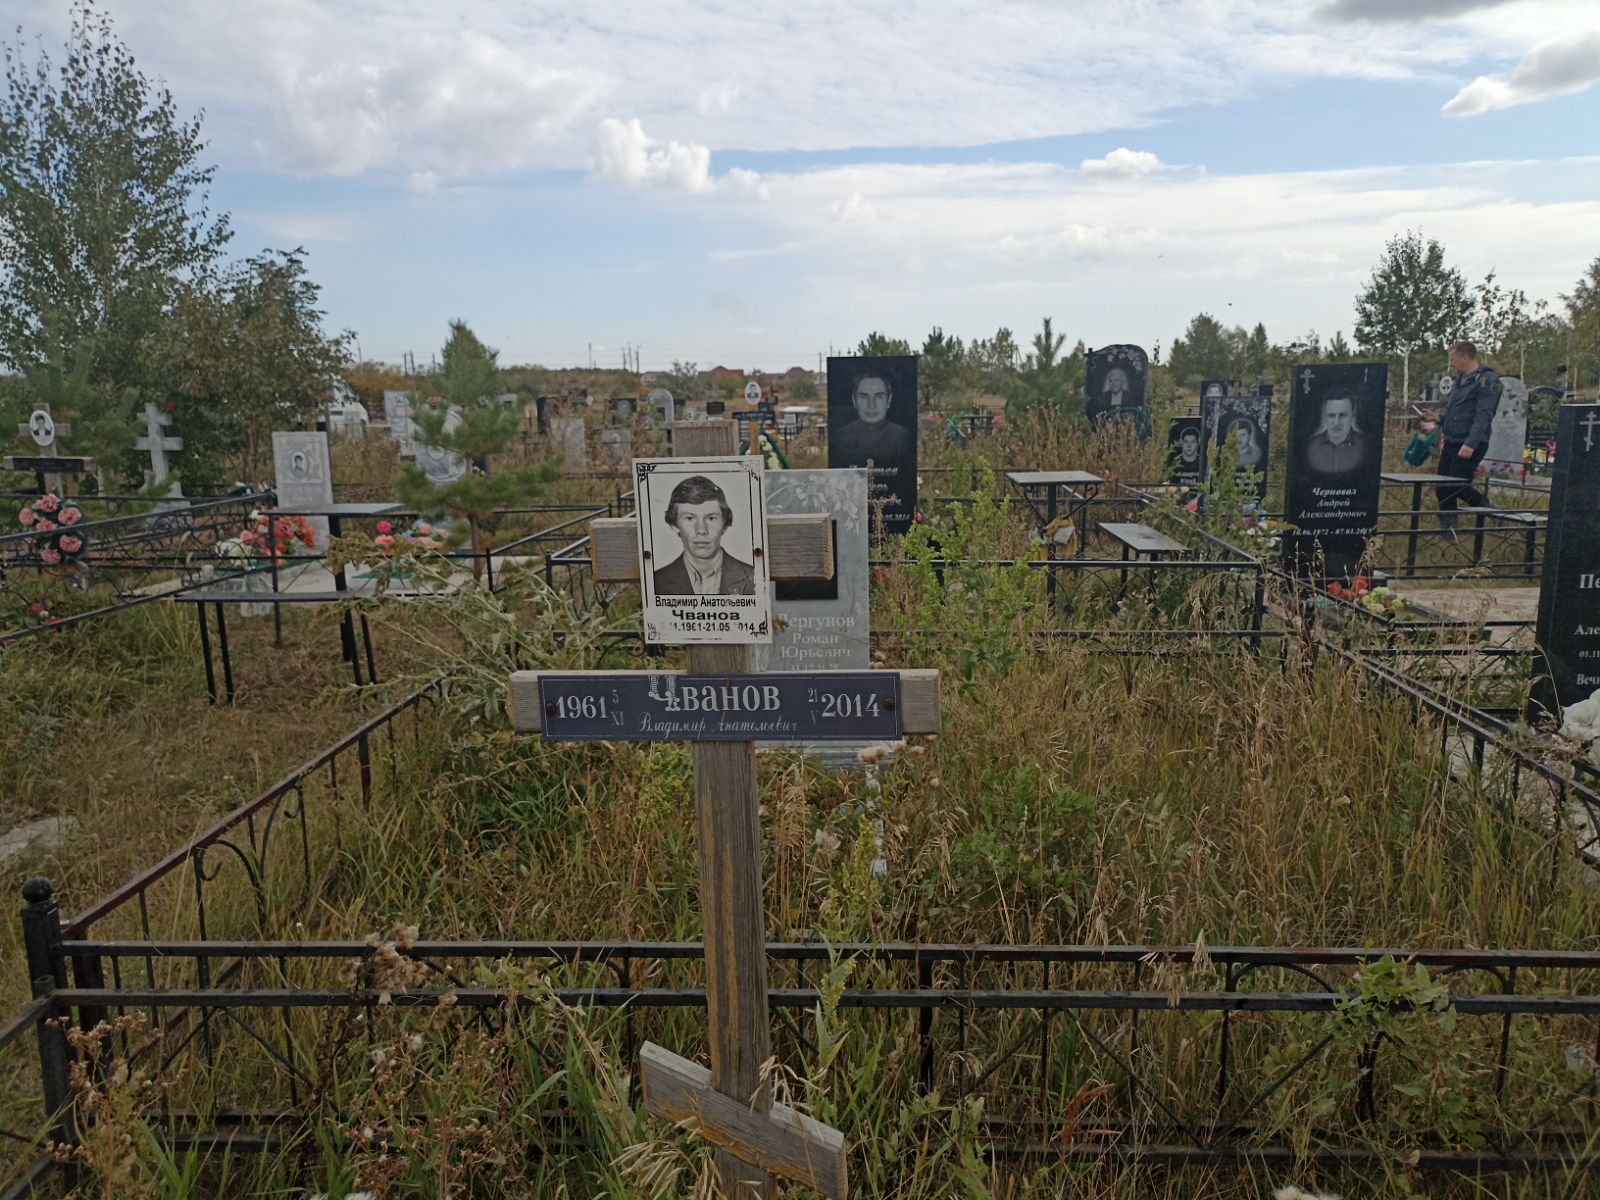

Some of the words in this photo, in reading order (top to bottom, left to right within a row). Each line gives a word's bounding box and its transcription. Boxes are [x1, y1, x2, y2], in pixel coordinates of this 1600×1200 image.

[1313, 487, 1357, 497] Черновол
[1317, 498, 1351, 508] Андрей
[1298, 510, 1367, 519] Александрович
[655, 596, 698, 609] Владимир
[700, 596, 756, 607] Анатольевич
[672, 609, 740, 621] Чванов
[793, 633, 839, 644] Роман
[781, 646, 851, 660] Юрьевич
[612, 689, 619, 703] 5
[648, 675, 781, 712] Чванов
[807, 687, 819, 703] 21
[556, 695, 609, 719] 1961
[821, 693, 880, 718] 2014
[637, 711, 707, 739] Владимир
[712, 712, 797, 731] Анатольевич
